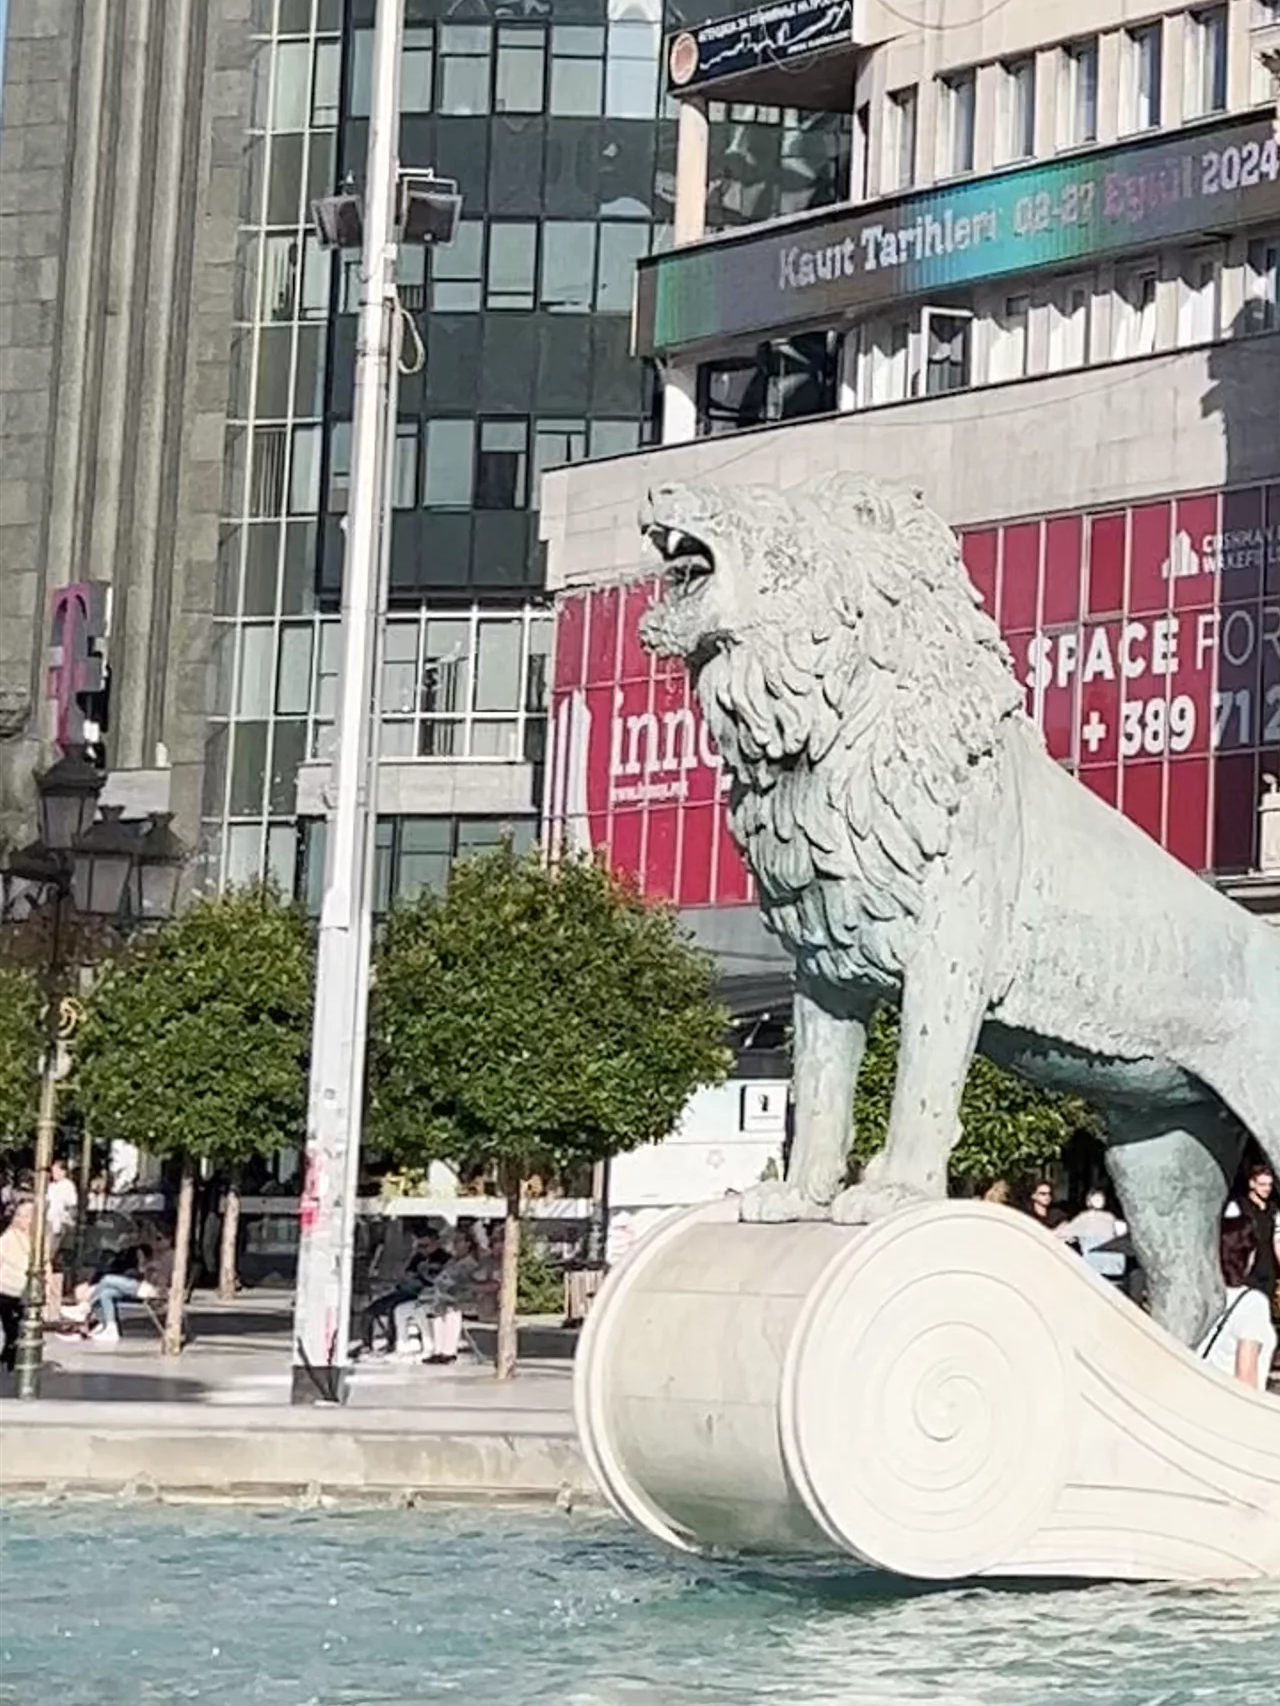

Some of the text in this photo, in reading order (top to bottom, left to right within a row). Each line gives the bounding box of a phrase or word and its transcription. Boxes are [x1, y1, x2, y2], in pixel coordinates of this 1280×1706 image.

[1201, 138, 1280, 195] 2024
[1026, 617, 1180, 689] SPACE
[1120, 693, 1197, 757] 389
